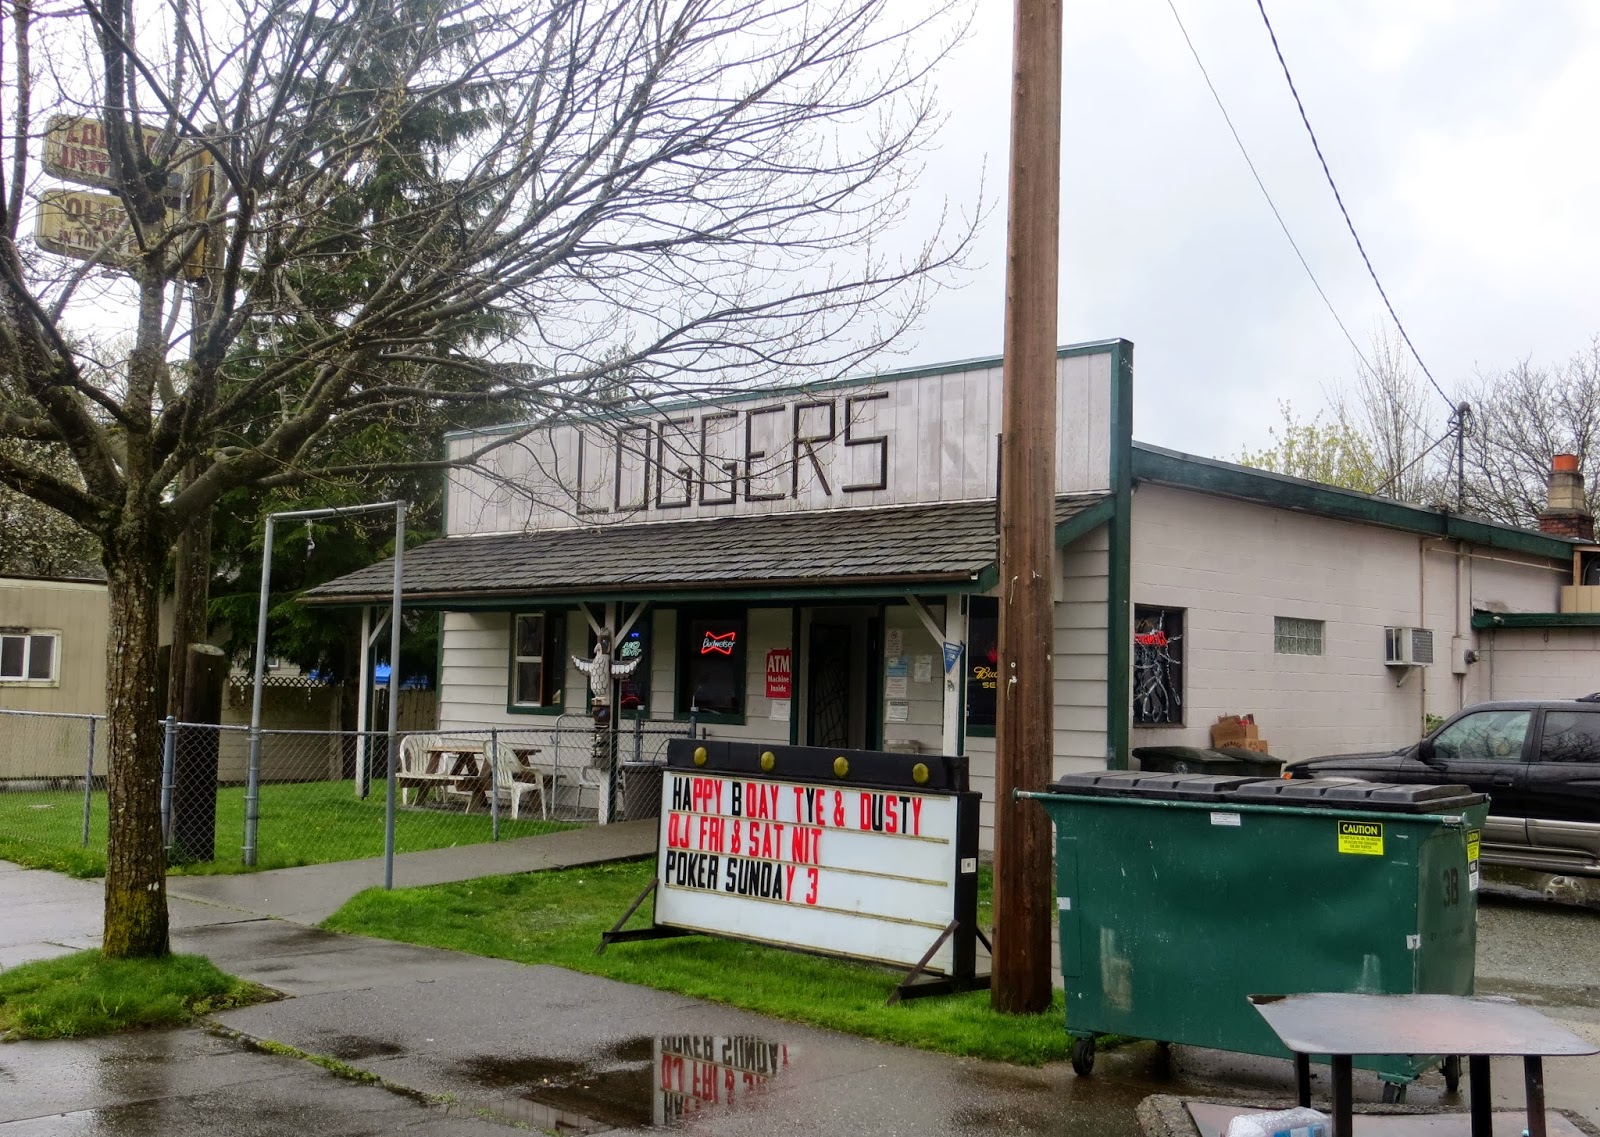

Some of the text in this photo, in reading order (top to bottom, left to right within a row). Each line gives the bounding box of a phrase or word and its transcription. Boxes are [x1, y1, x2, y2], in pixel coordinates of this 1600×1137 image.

[575, 391, 889, 515] LOGGERS
[703, 637, 736, 648] Budweiser
[767, 655, 790, 672] ATM
[768, 675, 790, 683] Machine
[673, 777, 723, 814] HAPPY
[793, 787, 826, 827] TYE
[833, 790, 845, 828] &
[860, 792, 922, 837] DUSTY
[668, 813, 823, 866] DJ FRI & SAT NIT
[1342, 824, 1378, 836] CAUTION
[666, 850, 820, 906] POKER SUNDAY 3
